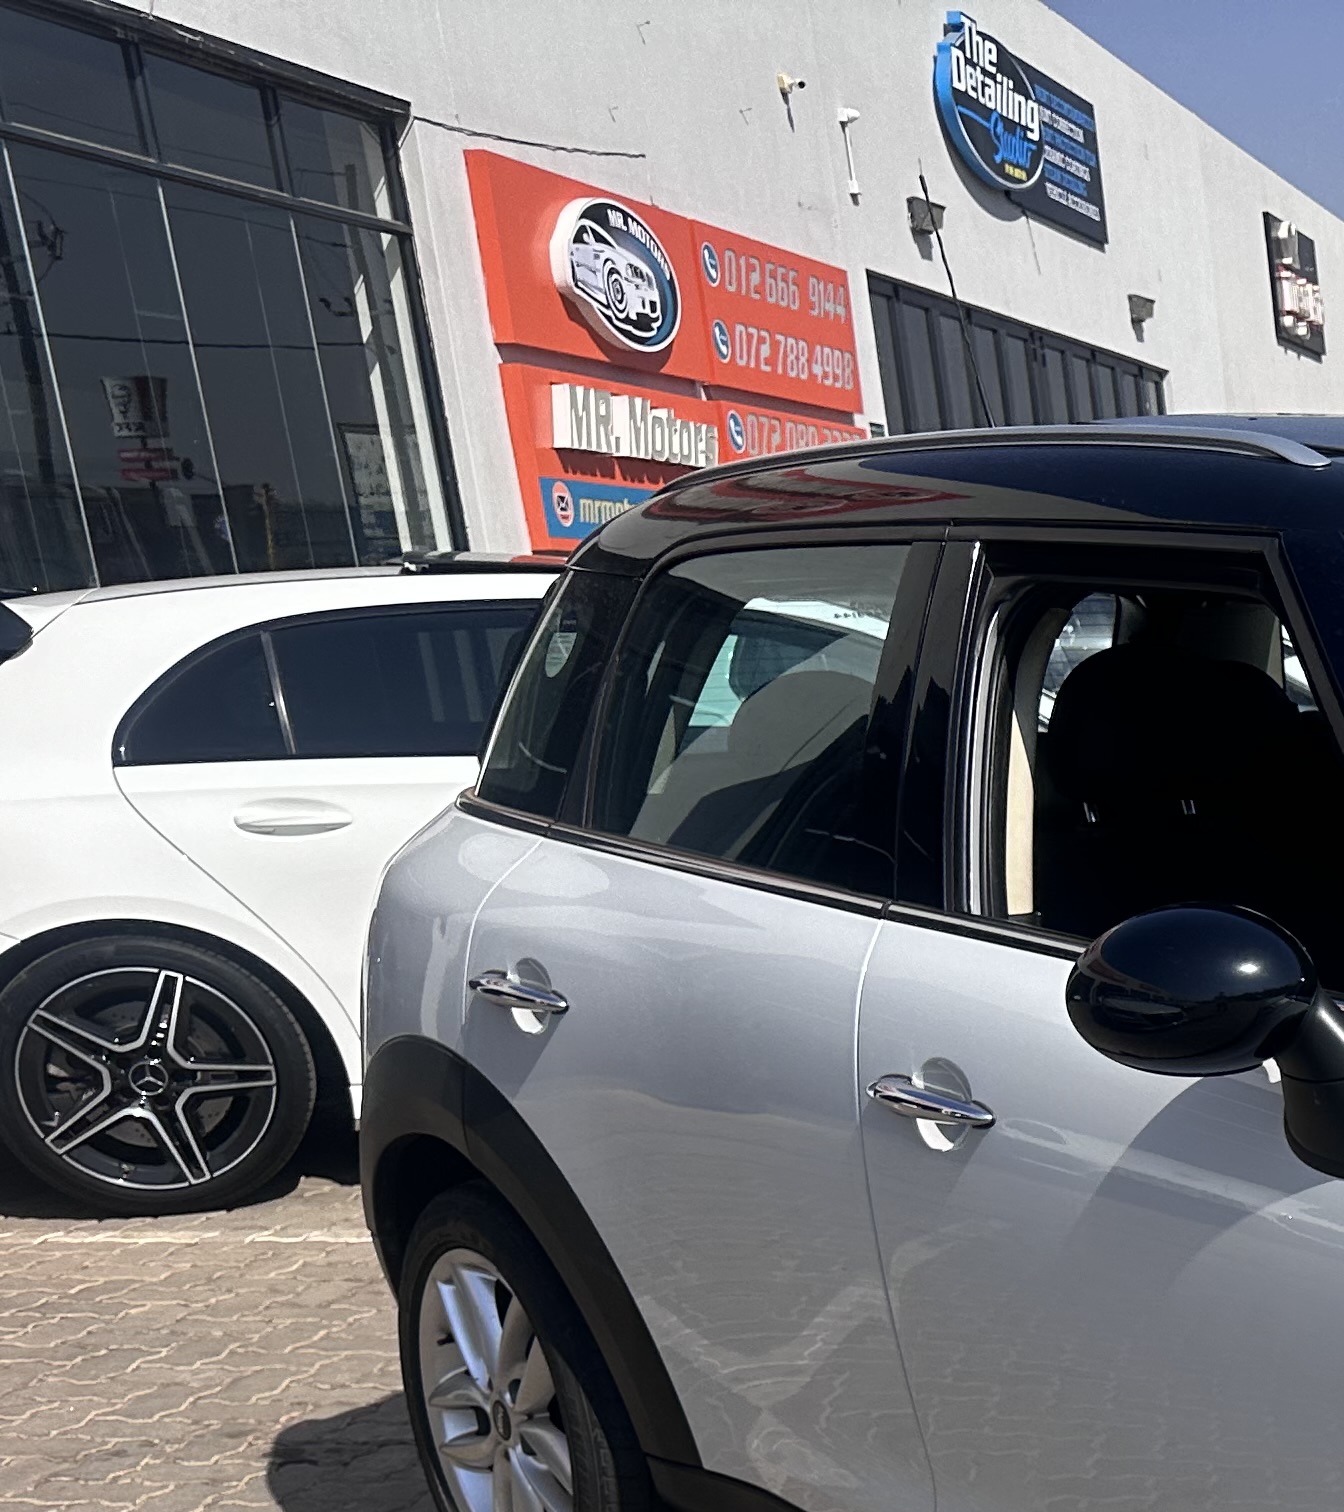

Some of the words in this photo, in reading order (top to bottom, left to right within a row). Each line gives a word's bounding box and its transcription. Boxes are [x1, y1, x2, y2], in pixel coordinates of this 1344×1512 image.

[960, 14, 998, 74] The
[950, 46, 1040, 142] Detailing
[724, 249, 761, 300] 012
[765, 262, 799, 310] 666
[808, 275, 847, 324] 9144
[735, 322, 772, 372] 072
[775, 333, 809, 380] 788
[811, 344, 854, 391] 4998
[562, 383, 621, 454] MR.
[622, 395, 719, 467] Motors
[746, 413, 781, 457] 072
